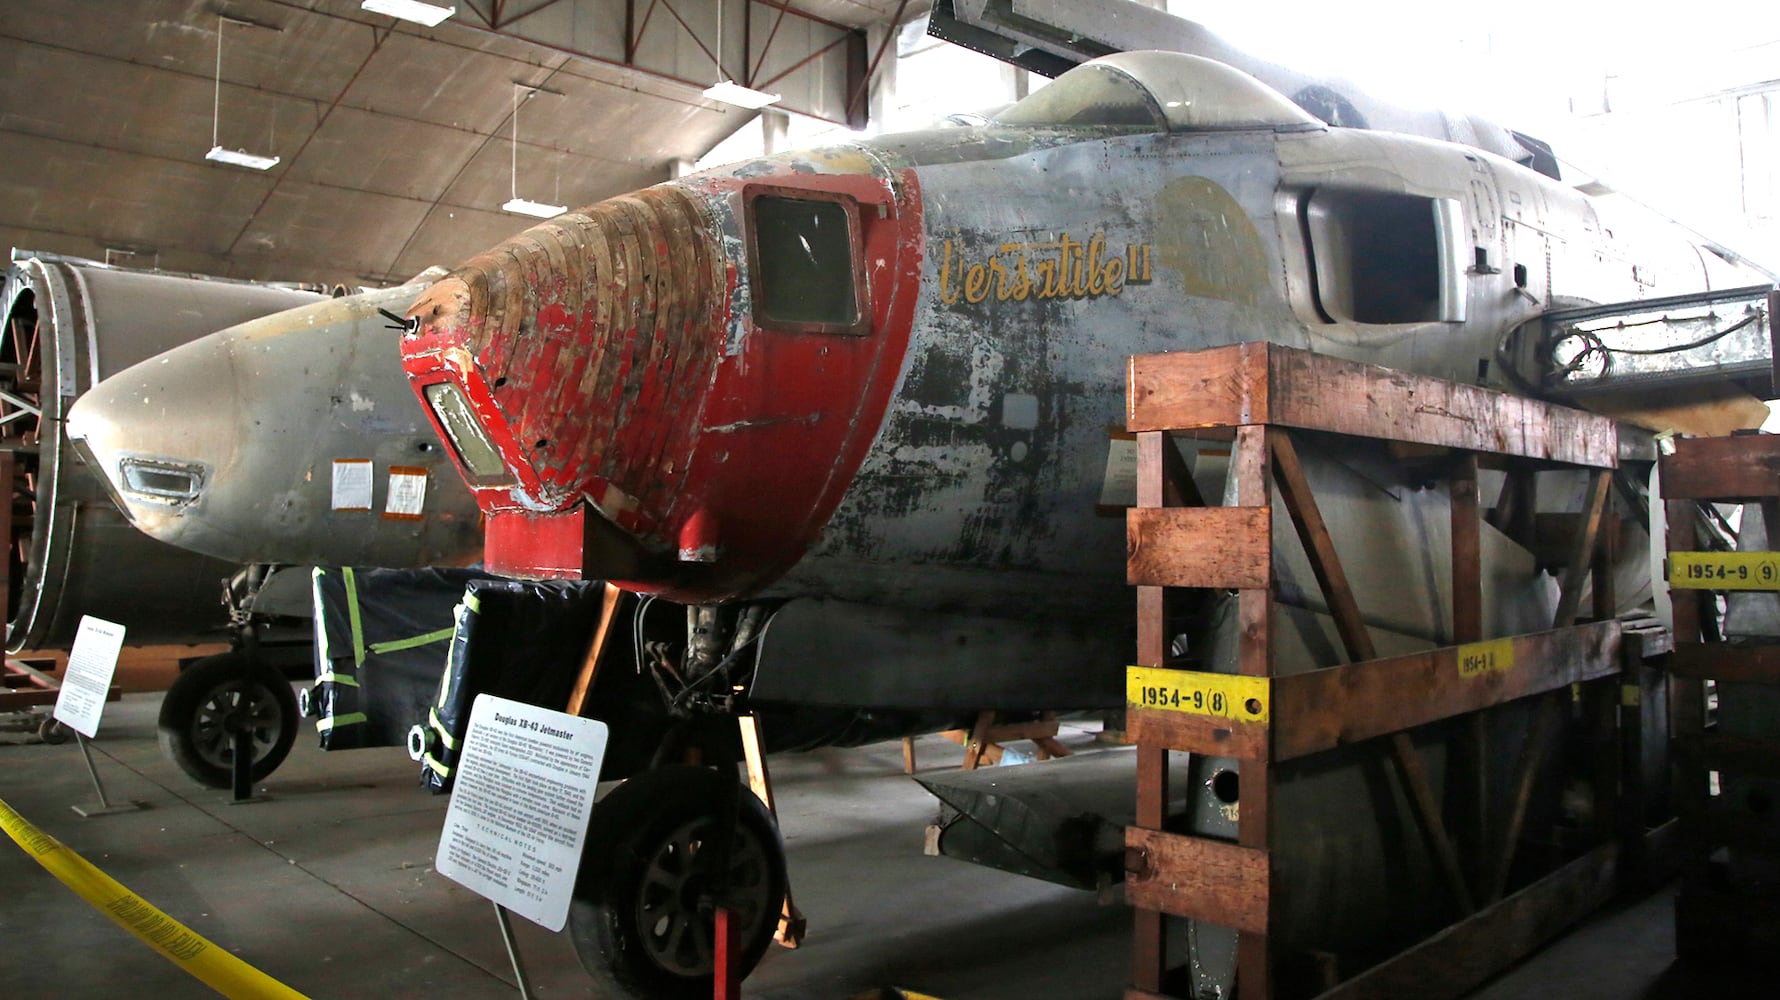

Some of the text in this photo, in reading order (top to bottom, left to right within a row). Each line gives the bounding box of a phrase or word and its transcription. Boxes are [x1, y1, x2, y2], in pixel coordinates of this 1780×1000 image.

[1687, 560, 1778, 585] 1954-9 (9)
[494, 712, 574, 741] Douglas XB-43 Jetmaster
